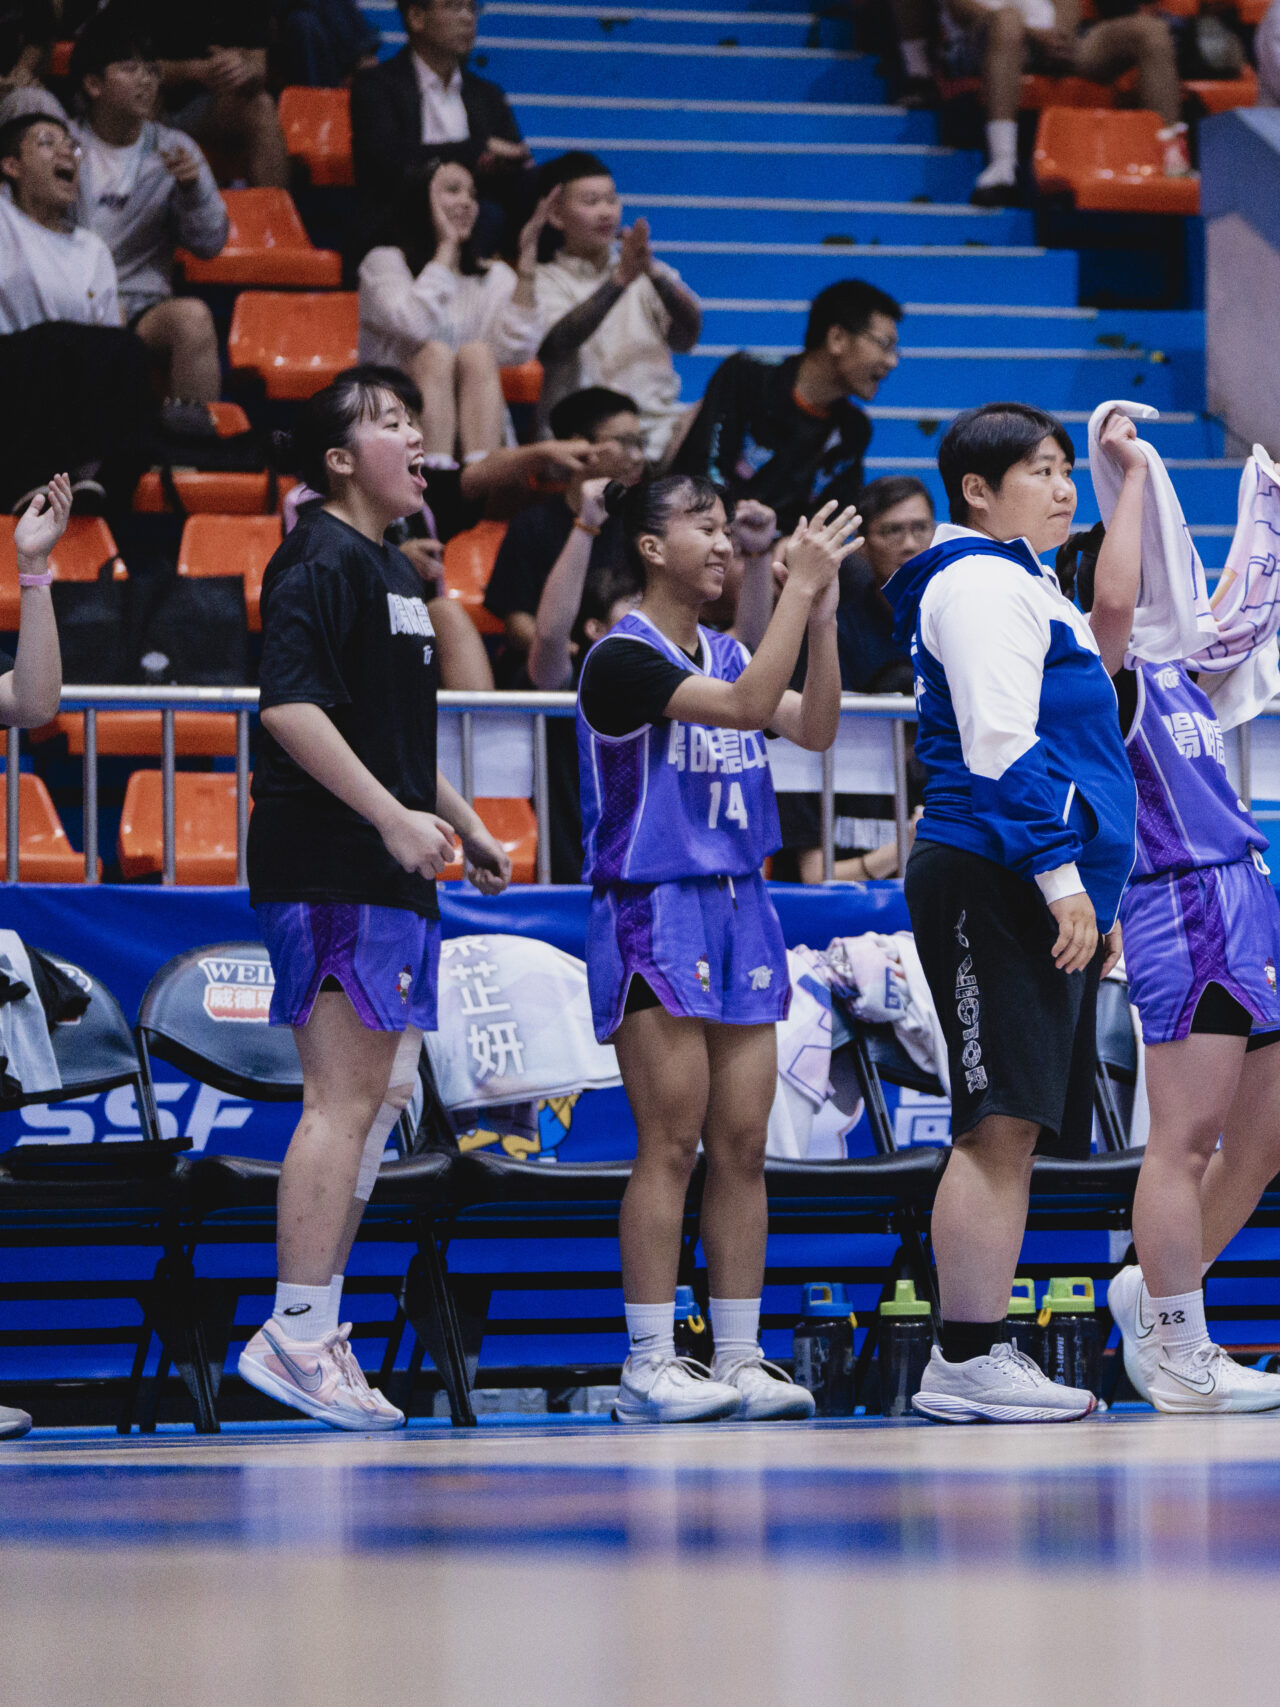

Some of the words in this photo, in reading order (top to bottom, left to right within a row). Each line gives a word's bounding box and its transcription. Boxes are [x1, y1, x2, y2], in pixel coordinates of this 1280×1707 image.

[708, 781, 748, 830] 14
[207, 961, 276, 985] WEI
[15, 1082, 254, 1152] SSF
[1158, 1310, 1186, 1326] 23
